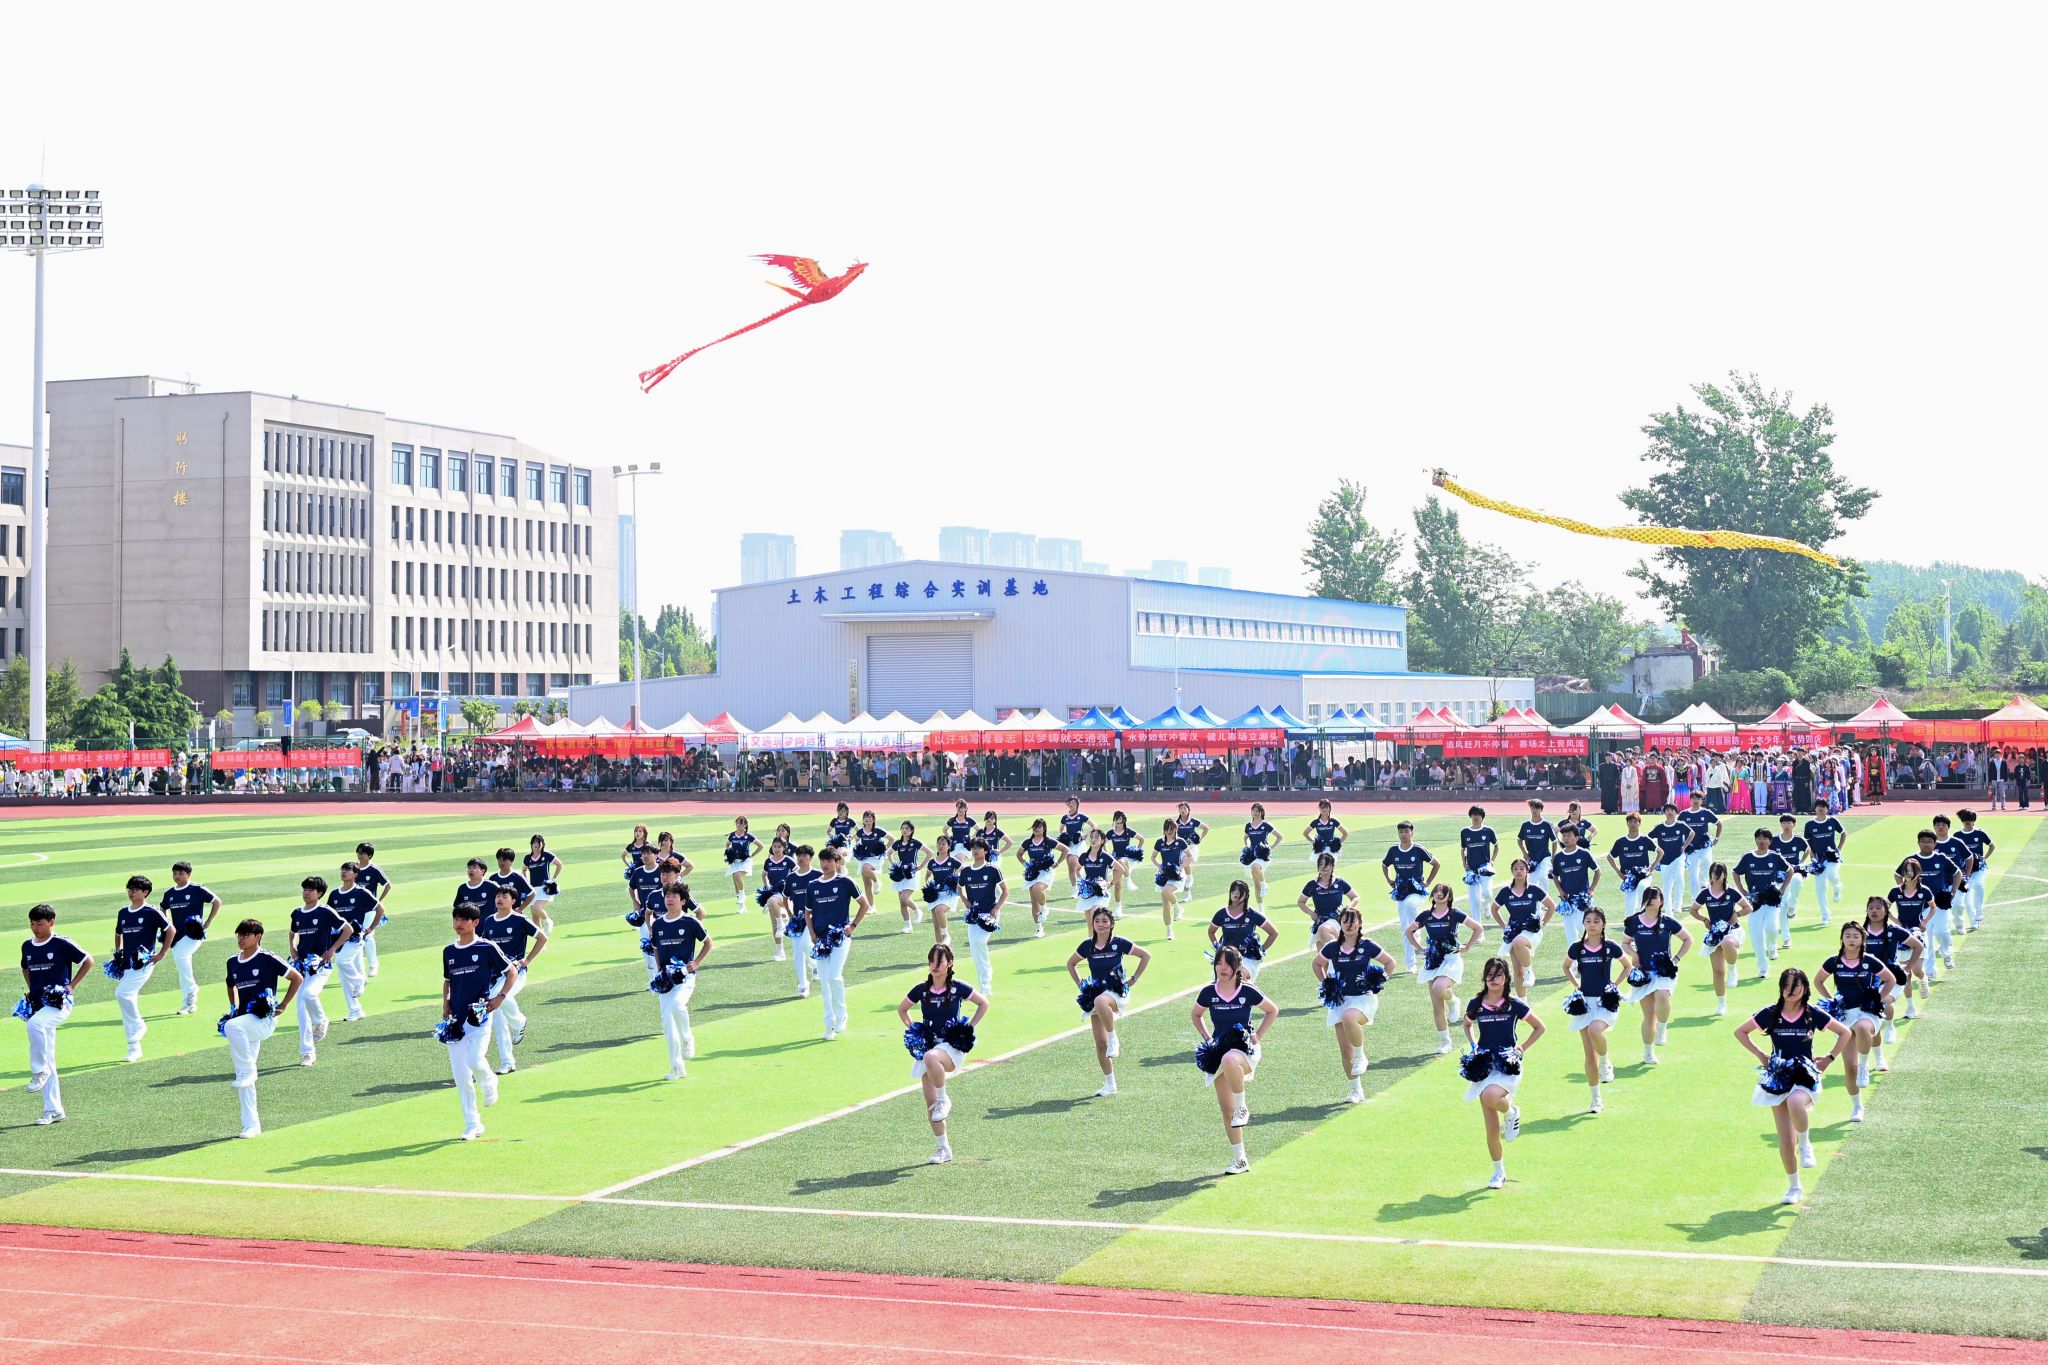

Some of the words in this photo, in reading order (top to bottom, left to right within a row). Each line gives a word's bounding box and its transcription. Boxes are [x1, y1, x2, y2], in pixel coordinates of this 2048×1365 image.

[787, 578, 1049, 604] 土木工程综合实训基地
[934, 734, 1016, 745] 以汗书写青春志
[1024, 733, 1109, 743] 以梦铸就交通强
[1128, 732, 1198, 742] 水势如虹冲霄汉
[1207, 731, 1279, 742] 健儿赛场立潮头
